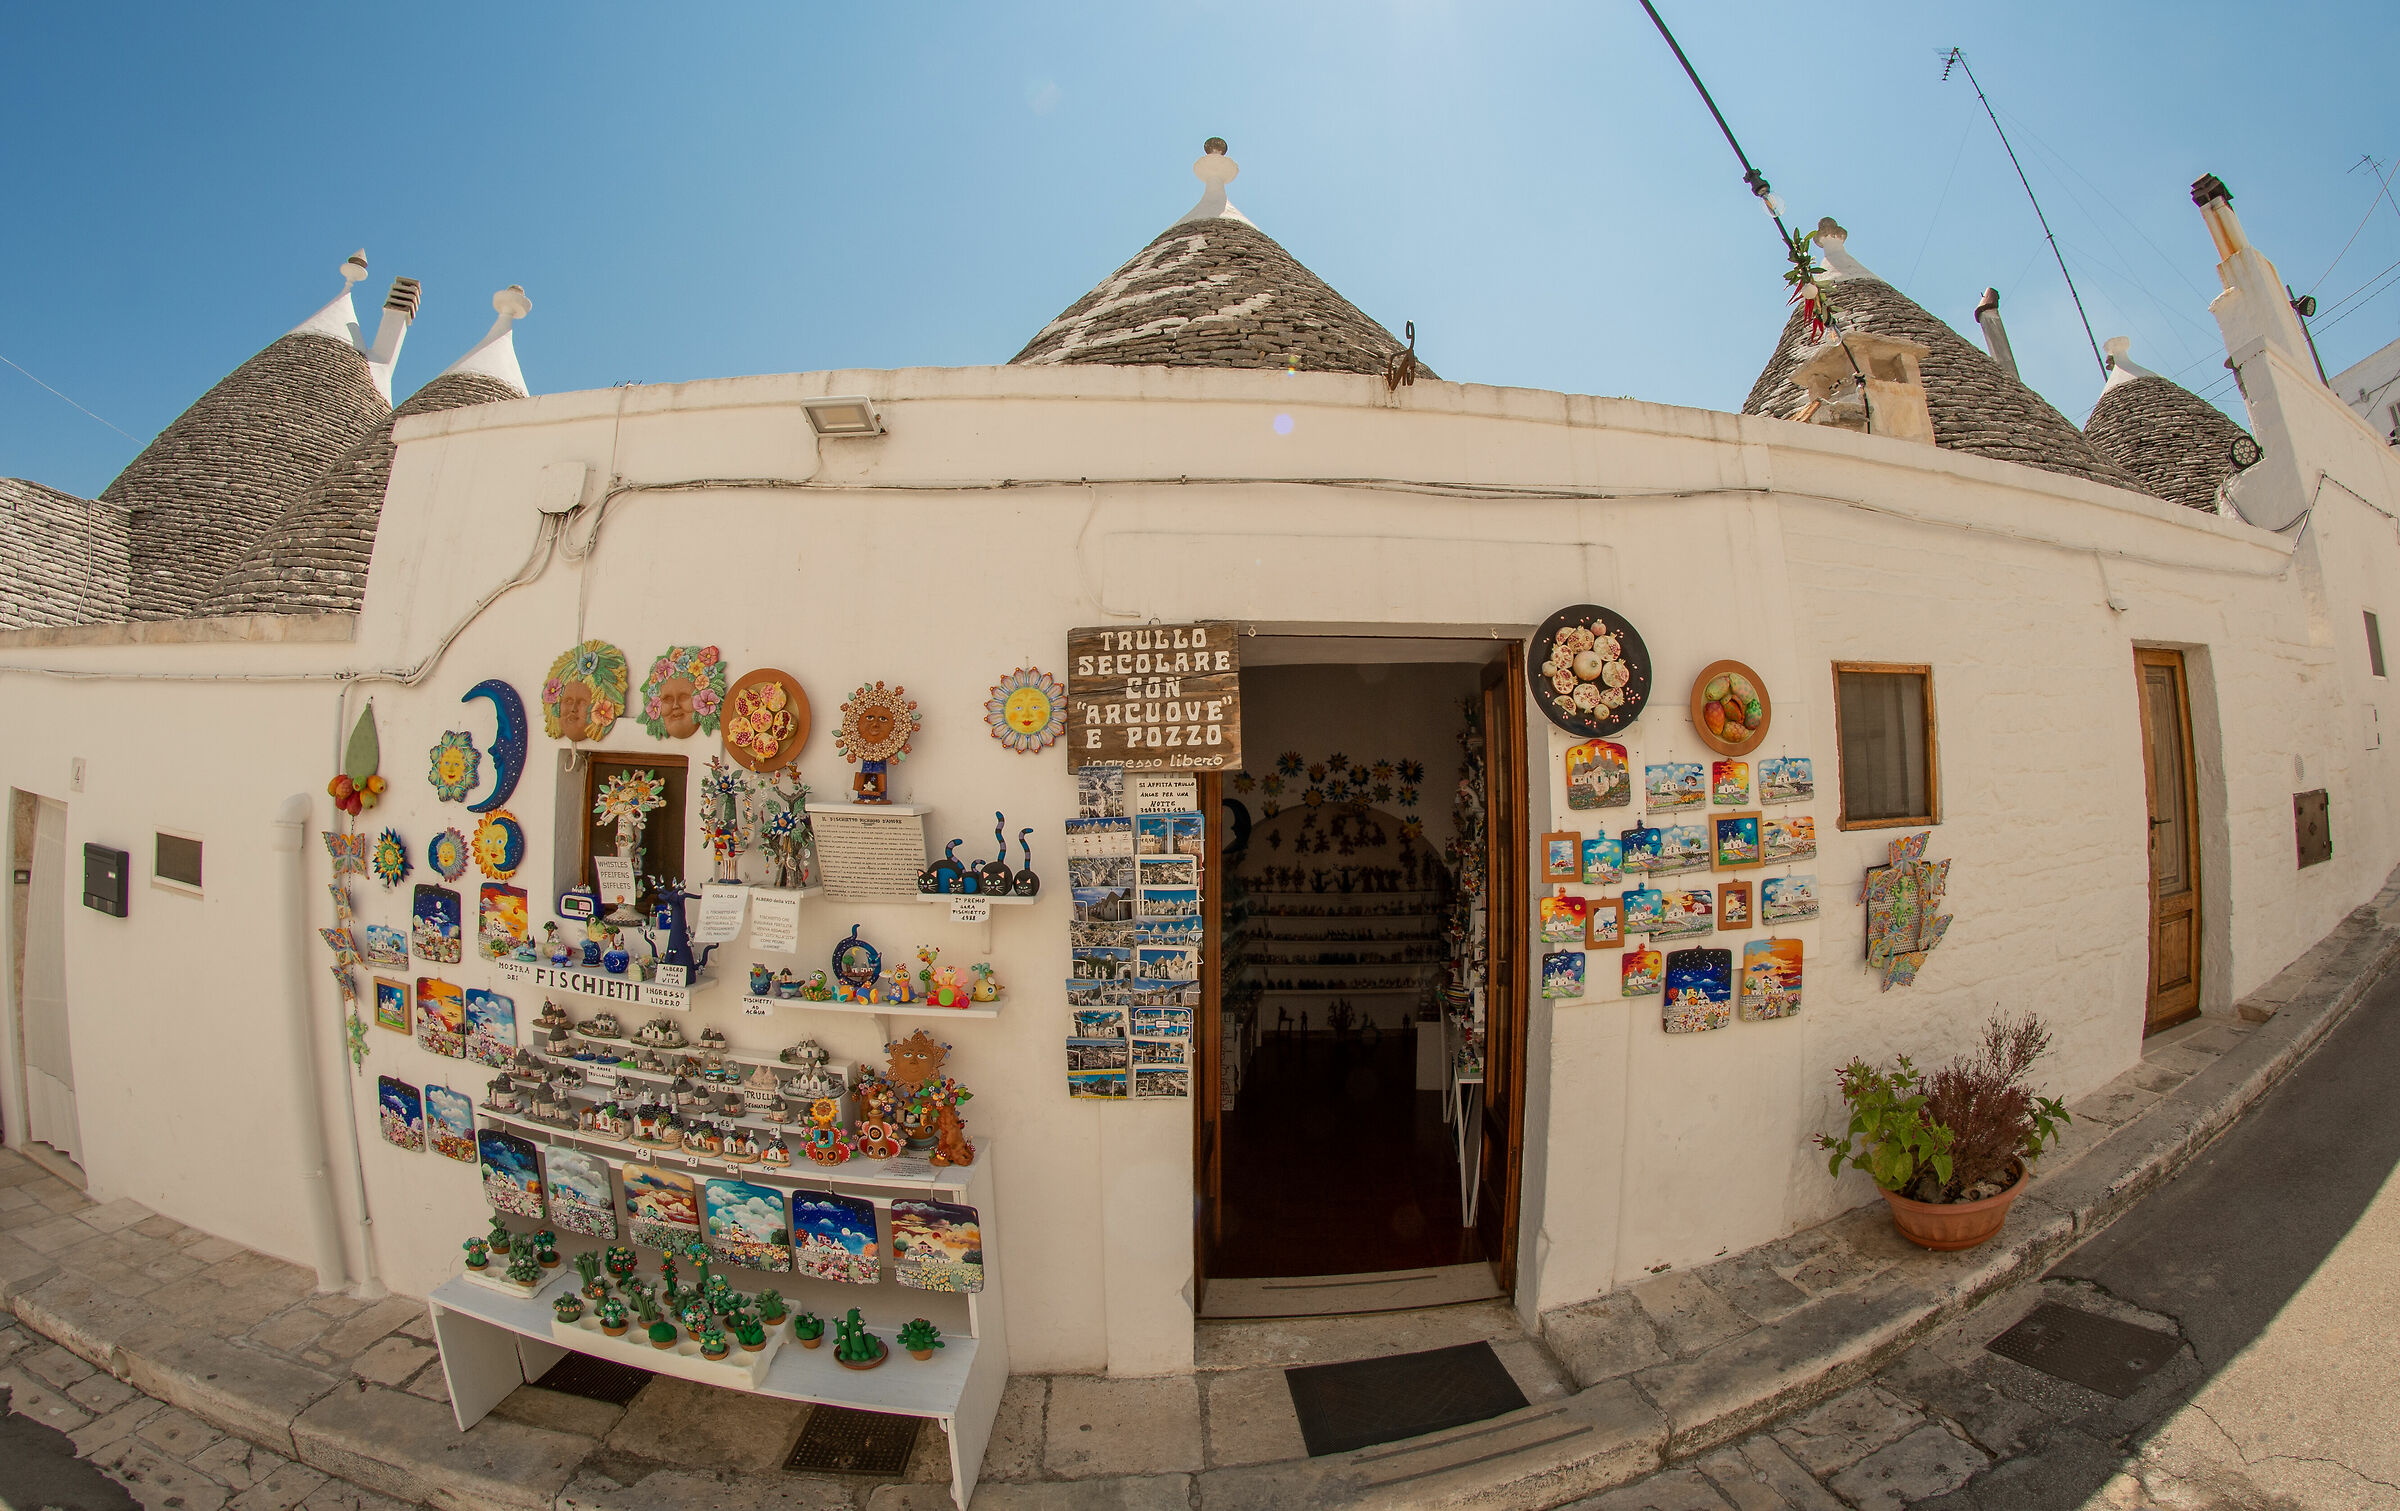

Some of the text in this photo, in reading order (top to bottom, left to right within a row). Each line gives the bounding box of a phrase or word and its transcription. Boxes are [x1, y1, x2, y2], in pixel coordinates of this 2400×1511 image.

[1100, 628, 1206, 650] TRULLO
[1079, 651, 1230, 675] SECOLARE
[1126, 677, 1181, 698] CON
[1086, 725, 1222, 748] E POZZO
[1170, 754, 1223, 767] libero
[499, 962, 529, 974] MOSTRA
[536, 968, 640, 1001] FISCHIETTI
[646, 987, 685, 999] INGRESSO
[651, 998, 681, 1007] LIBERO
[744, 1091, 774, 1100] TRULLI
